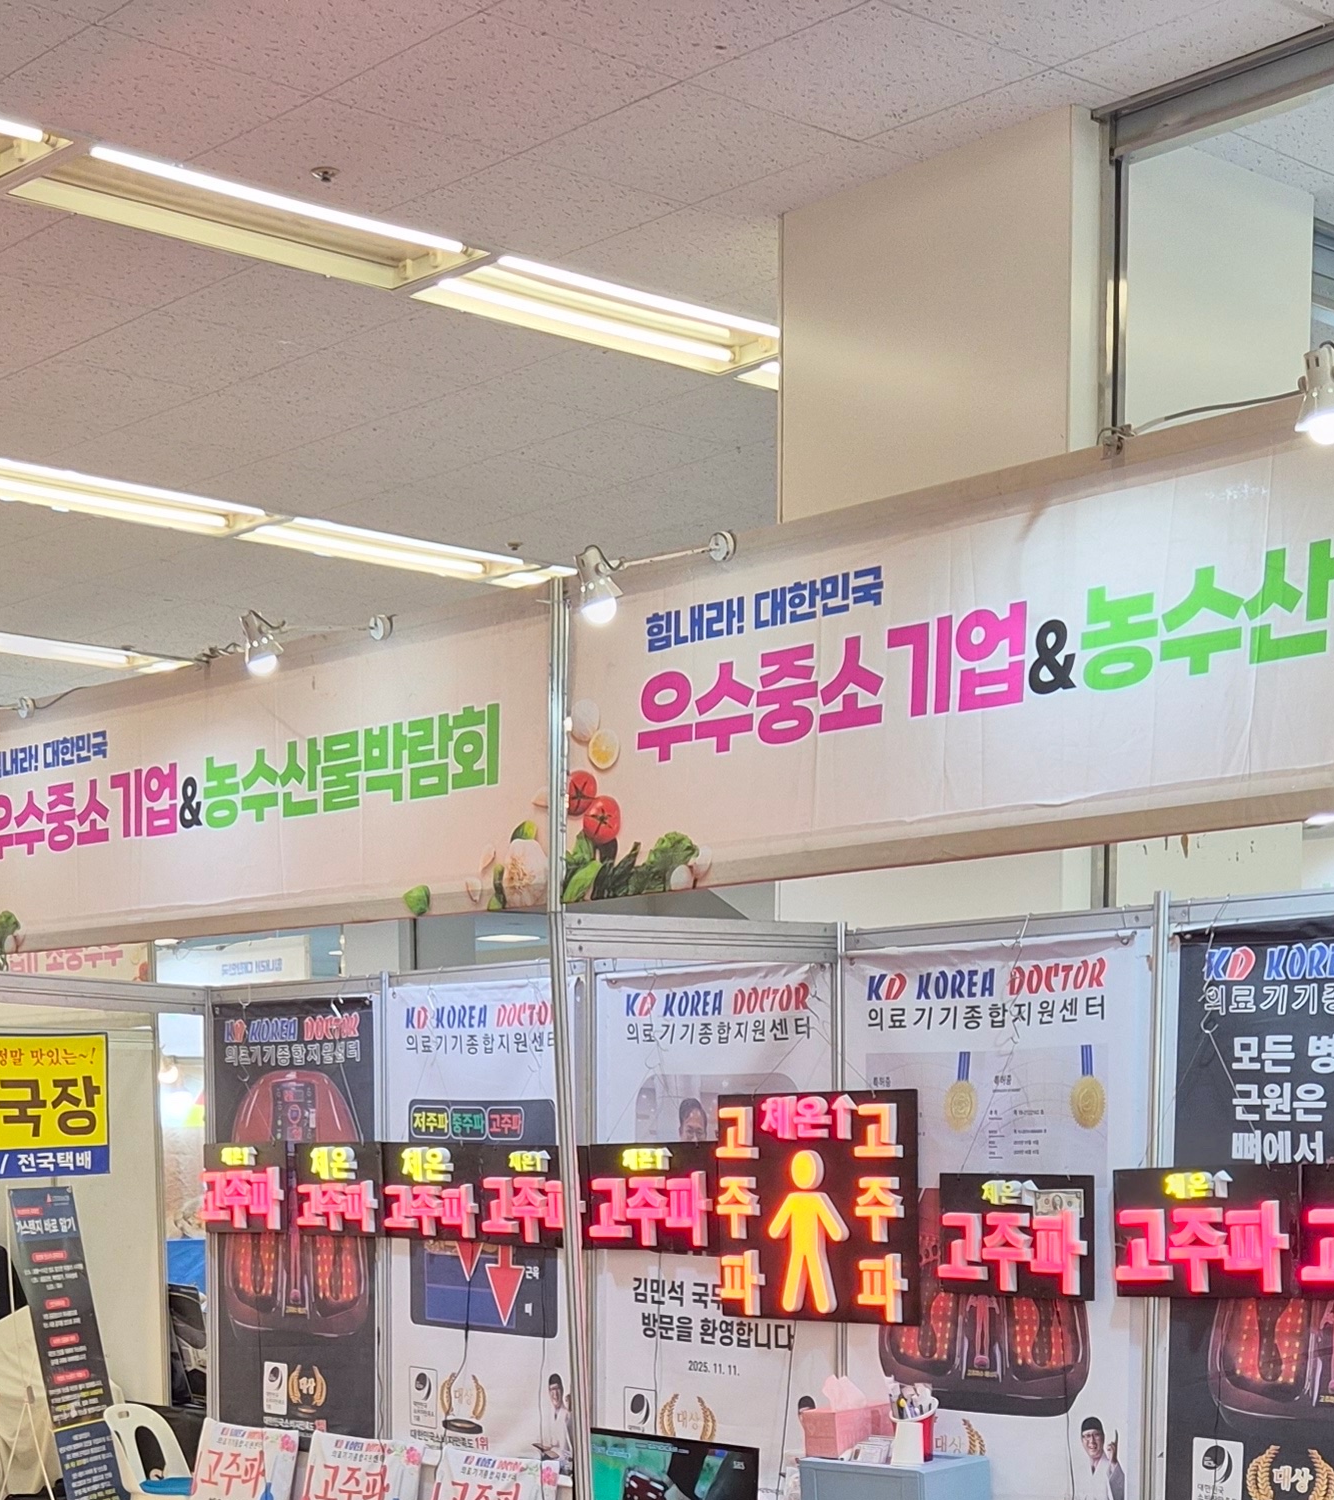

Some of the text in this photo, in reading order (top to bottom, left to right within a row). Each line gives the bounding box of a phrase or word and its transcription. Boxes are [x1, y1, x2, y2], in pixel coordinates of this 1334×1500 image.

[645, 564, 883, 653] 힘내라! 대한민국
[43, 729, 108, 770] 대한민국
[868, 957, 1106, 1001] KD KOREA DOCTOR
[1204, 947, 1255, 981] KD
[405, 1005, 487, 1029] KD KOREA
[626, 982, 809, 1017] KD KOREA DOCTOR
[867, 995, 1106, 1031] 의료기기종합지원센터
[249, 1017, 298, 1042] KOREA
[304, 1012, 360, 1040] DOCTOR
[626, 1016, 811, 1045] 의료기기종합지원센터
[225, 1040, 361, 1067] 의료기기종합지원센터
[1232, 1035, 1295, 1073] 모든
[1232, 1082, 1327, 1121] 근원은
[413, 1111, 522, 1134] 저주파 중주파 고주파
[17, 1150, 92, 1172] 전국택배
[1232, 1131, 1324, 1164] 뼈에서
[201, 1167, 284, 1229] 고주파
[298, 1180, 378, 1234] 고주파
[384, 1184, 477, 1238] 고주파
[589, 1171, 712, 1246] 고주파
[938, 1211, 1088, 1295] 고주파
[1116, 1200, 1288, 1292] 고주파
[632, 1277, 684, 1307] 김민석
[641, 1312, 795, 1350] 방문을 환영합니다
[201, 1449, 265, 1498] 고주파
[1272, 1465, 1313, 1493] 대상
